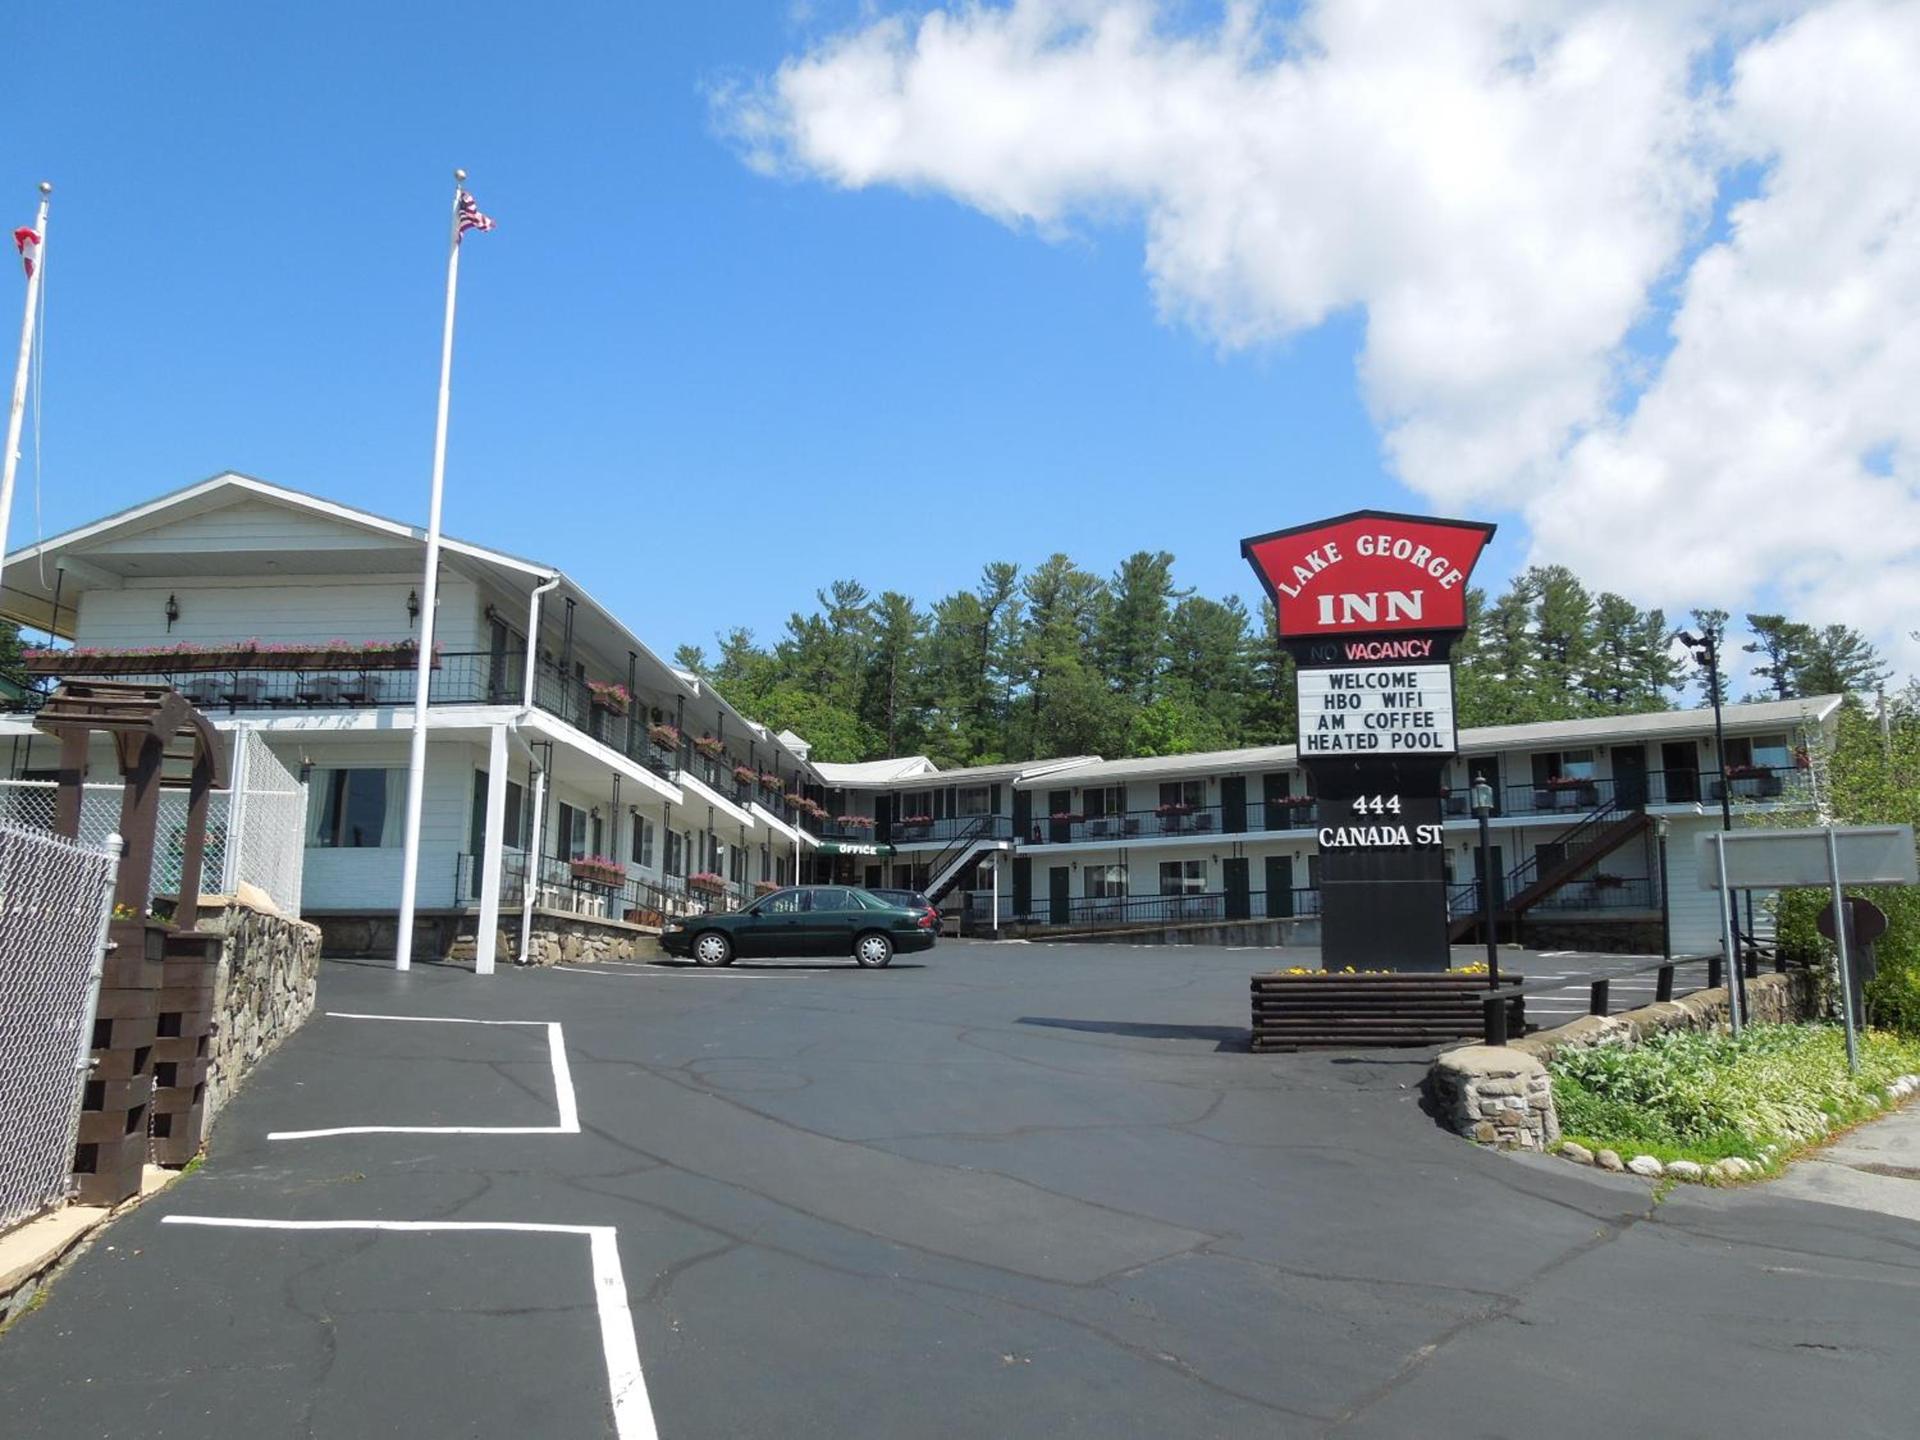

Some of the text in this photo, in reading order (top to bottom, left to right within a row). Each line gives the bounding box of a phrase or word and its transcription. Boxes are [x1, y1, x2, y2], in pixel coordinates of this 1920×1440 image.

[1278, 535, 1463, 599] LAKE GEORGE
[1317, 590, 1424, 625] INN
[1311, 639, 1433, 661] NO VACANCY
[1329, 672, 1418, 690] WELCOME
[1324, 691, 1423, 710] HBO WIFI
[1317, 711, 1434, 731] AM COFFEE
[1307, 732, 1443, 751] HEATED POOL
[1352, 794, 1401, 815] 444
[1318, 824, 1443, 847] CANADA ST
[838, 843, 877, 855] OFFICE
